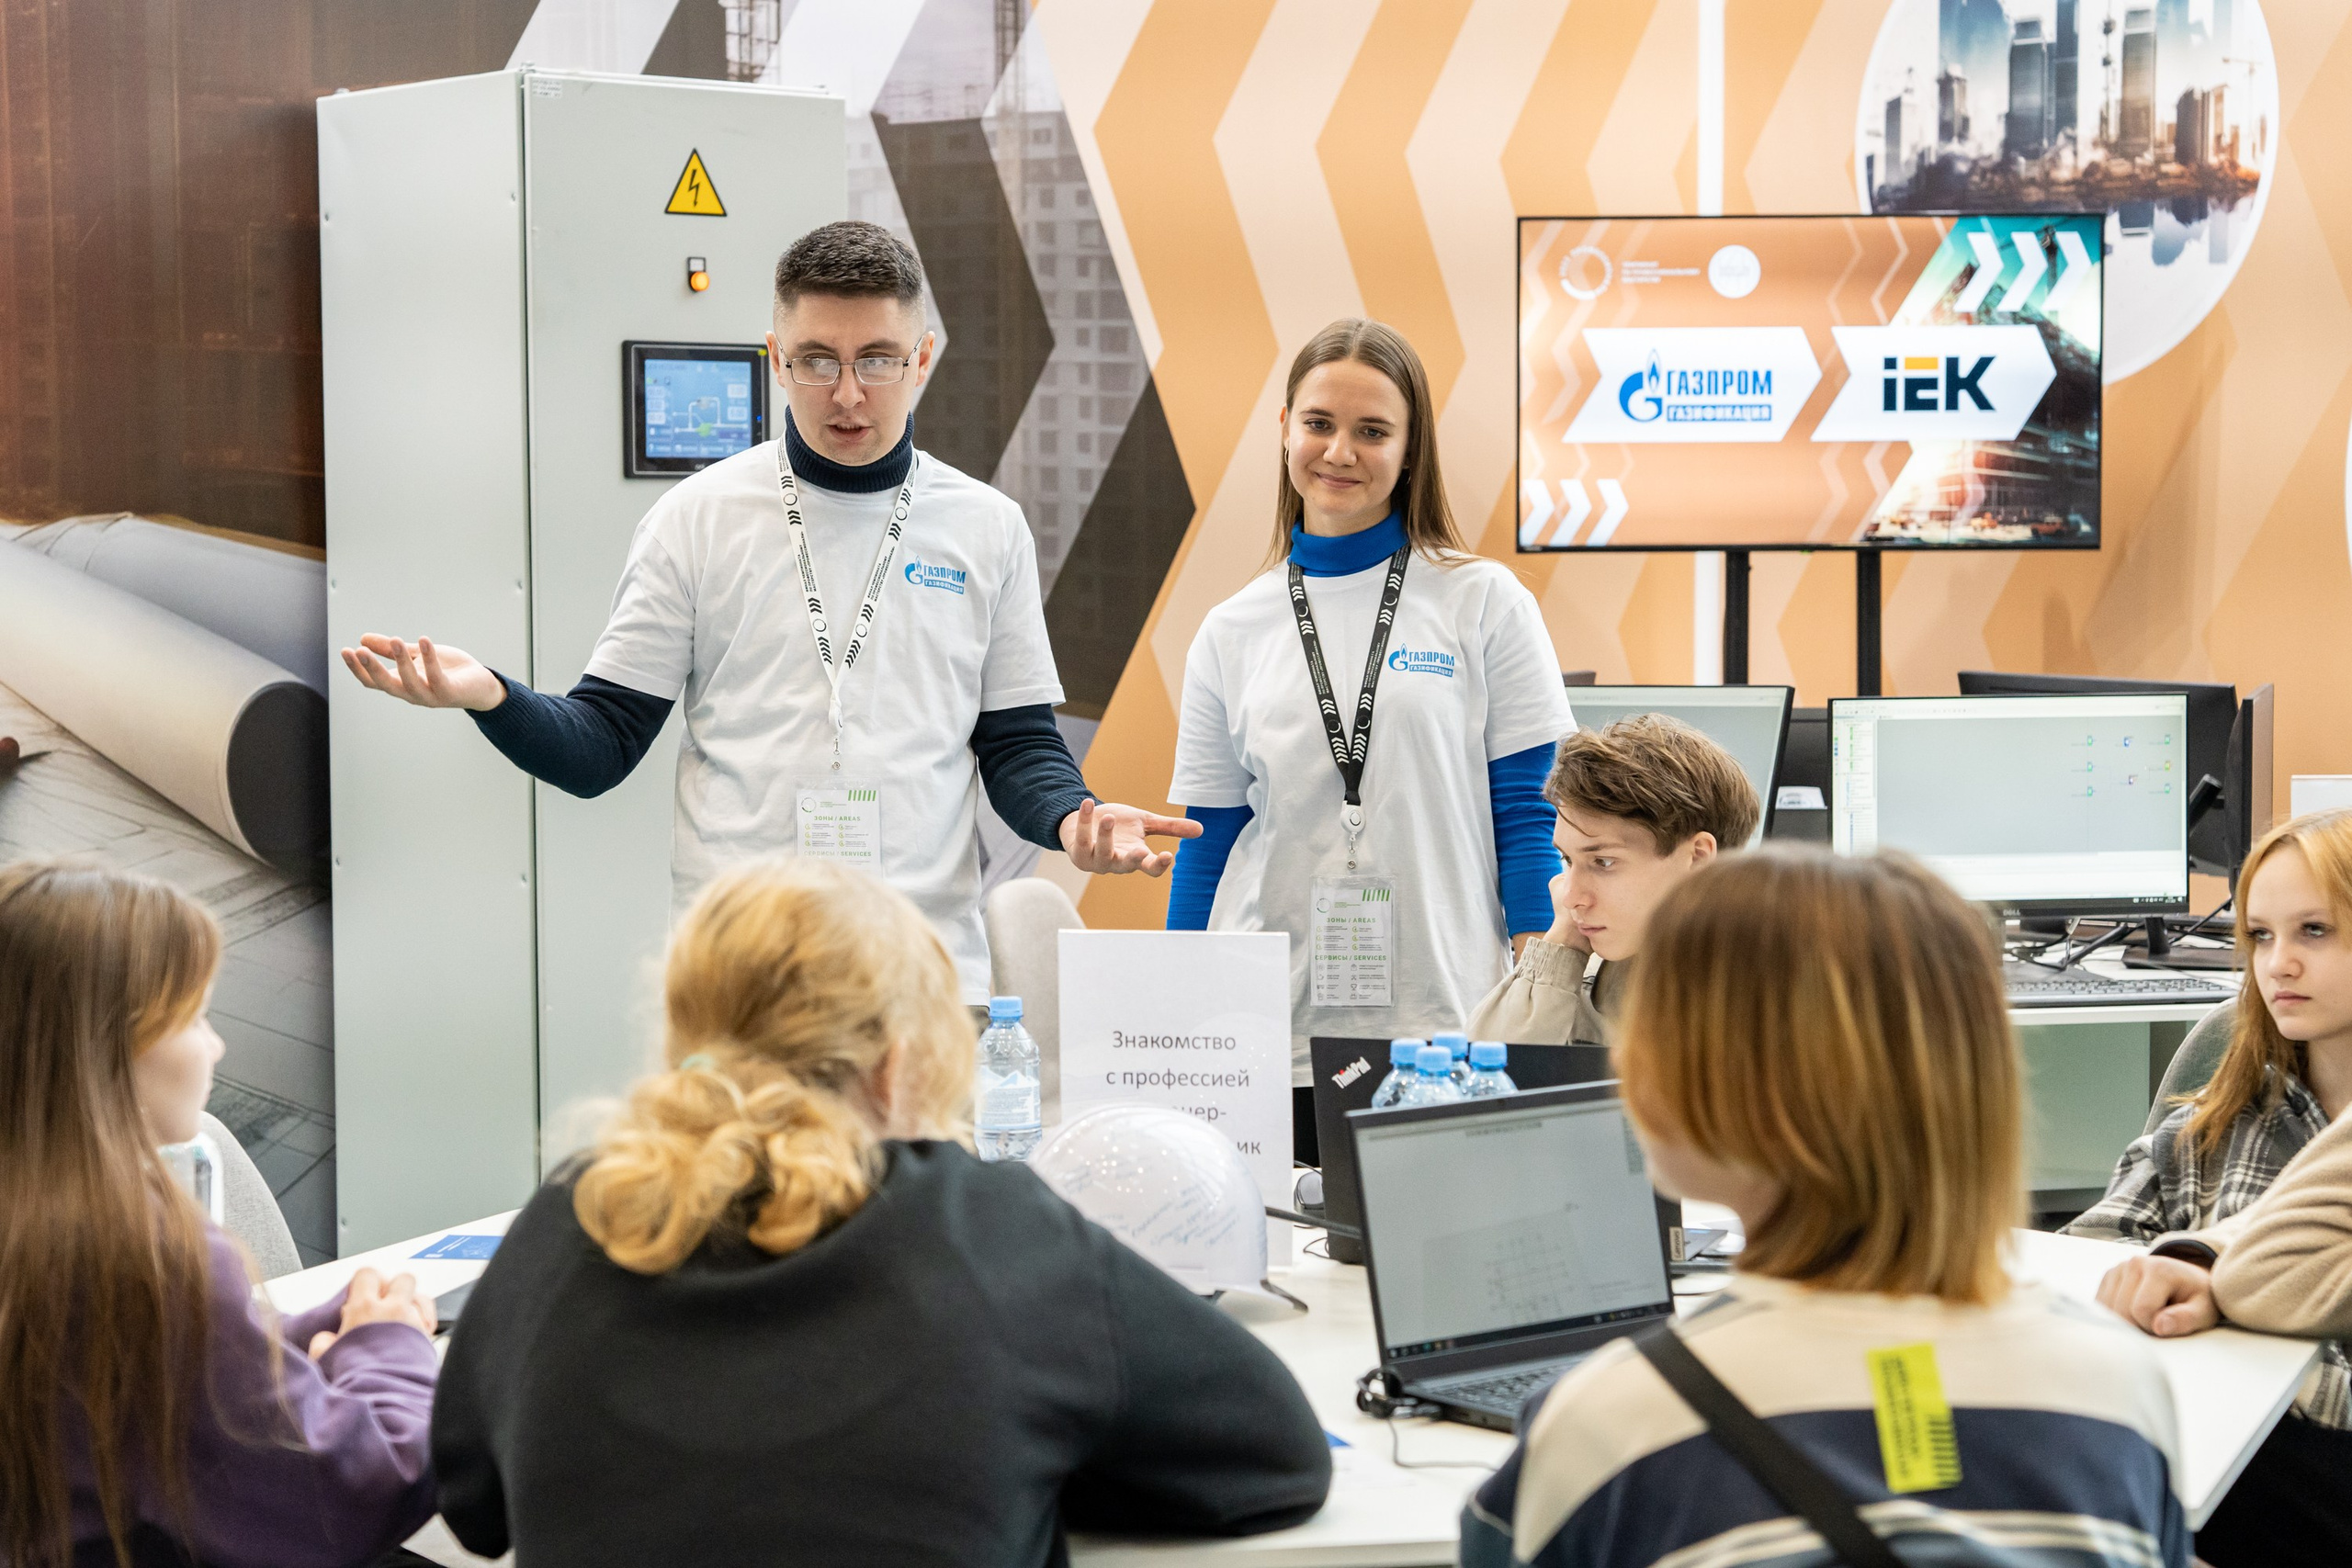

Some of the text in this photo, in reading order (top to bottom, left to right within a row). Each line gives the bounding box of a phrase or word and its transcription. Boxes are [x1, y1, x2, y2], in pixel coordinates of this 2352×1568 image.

[1667, 370, 1771, 395] ГАЗПРОМ
[1668, 406, 1771, 421] ГАЗИФИКАЦИЯ
[923, 565, 966, 583] ГАЗПРОМ
[1409, 652, 1454, 666] ГАЗПРОМ
[1409, 665, 1453, 677] ГАЗИФИКАЦИЯ
[1112, 1031, 1237, 1051] Знакомство
[1105, 1068, 1250, 1090] с профессией
